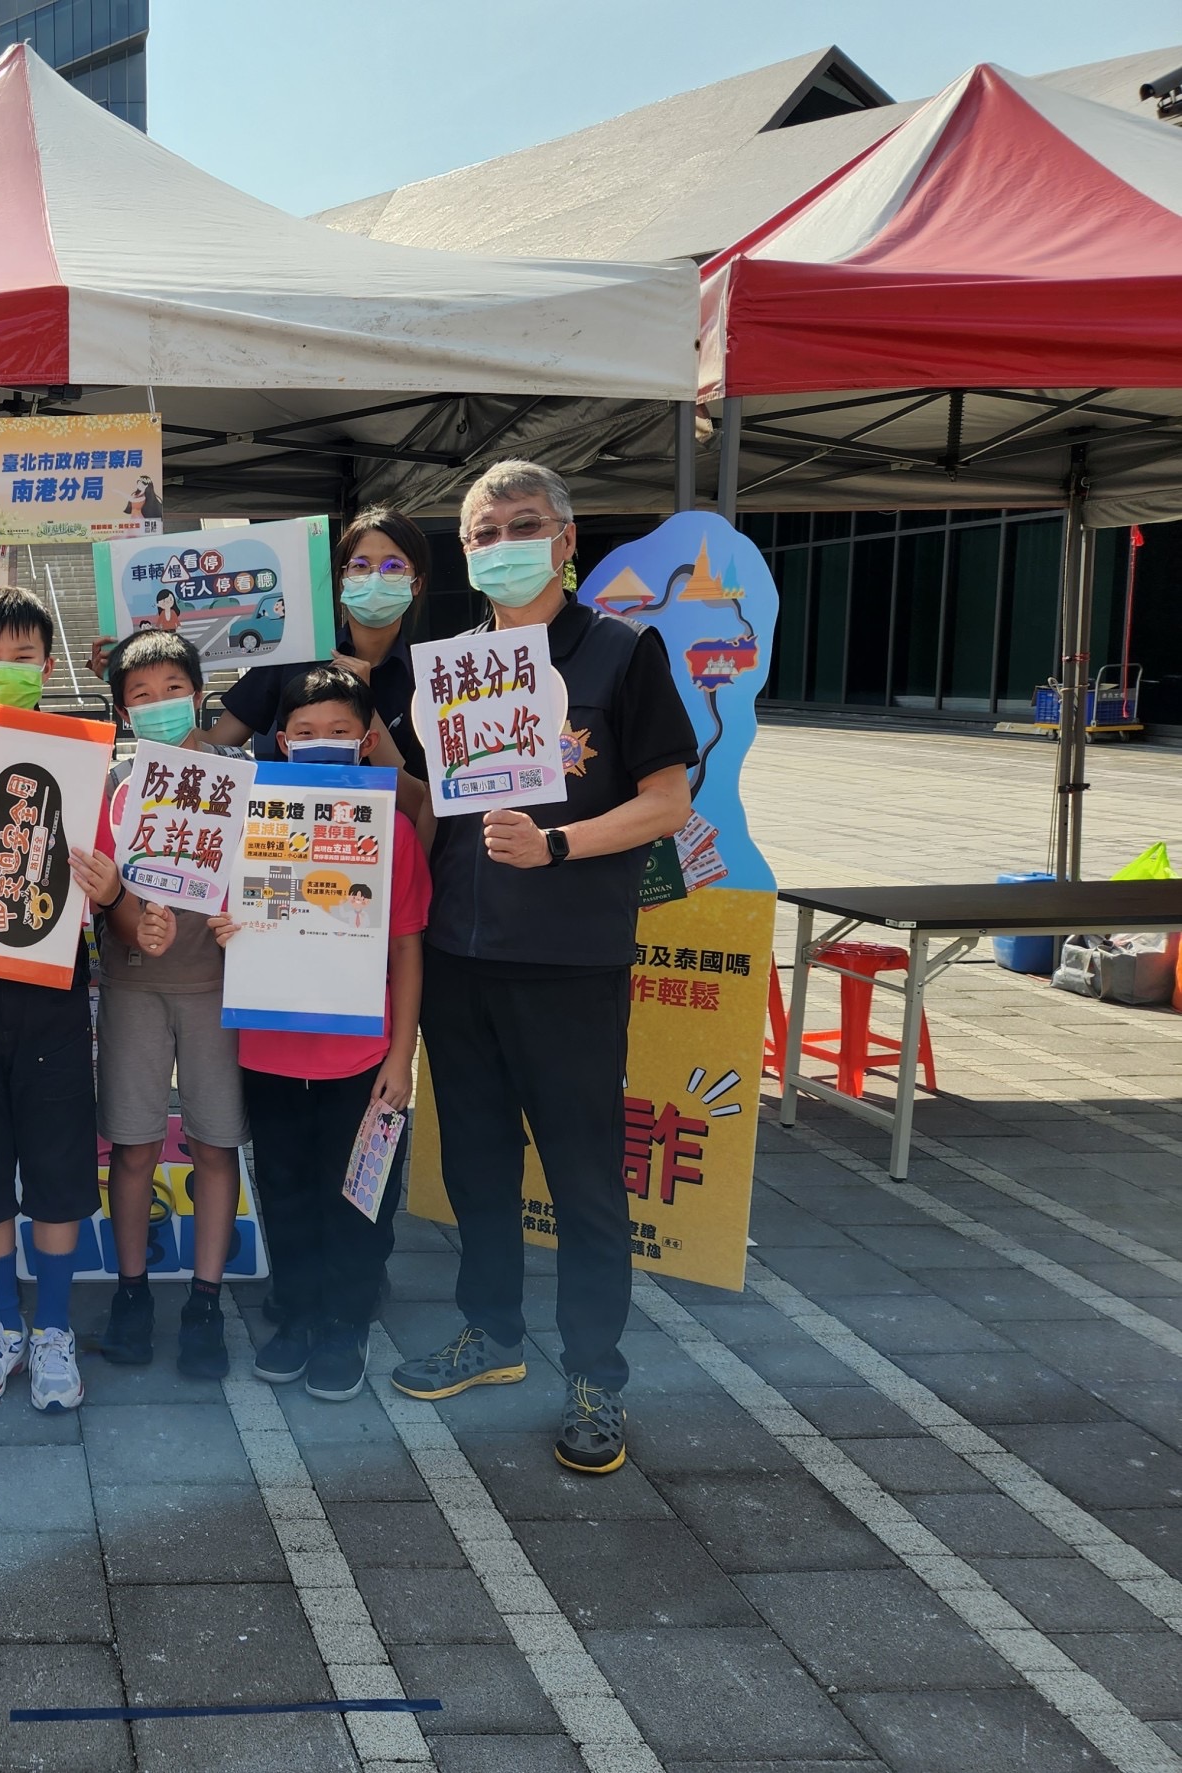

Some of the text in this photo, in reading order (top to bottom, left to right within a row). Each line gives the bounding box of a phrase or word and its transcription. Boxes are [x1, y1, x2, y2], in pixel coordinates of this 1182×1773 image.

[2, 449, 143, 473] 臺北市政府警察局
[11, 476, 104, 503] 南港分局
[180, 570, 274, 598] 行人停看聽
[430, 645, 536, 705] 南港分局
[437, 705, 545, 768] 關心你
[141, 761, 236, 818] 防竊盜
[248, 800, 373, 823] 閃黃燈 閃紅燈
[128, 813, 224, 873] 反詐騙
[247, 821, 356, 839] 要減速 要停車
[248, 840, 352, 854] 出現在幹道 出現在支道
[638, 884, 673, 896] TAIWAN
[643, 893, 672, 903] PASSPORT
[631, 974, 721, 1011] 作輕鬆
[624, 1096, 709, 1206] 詐
